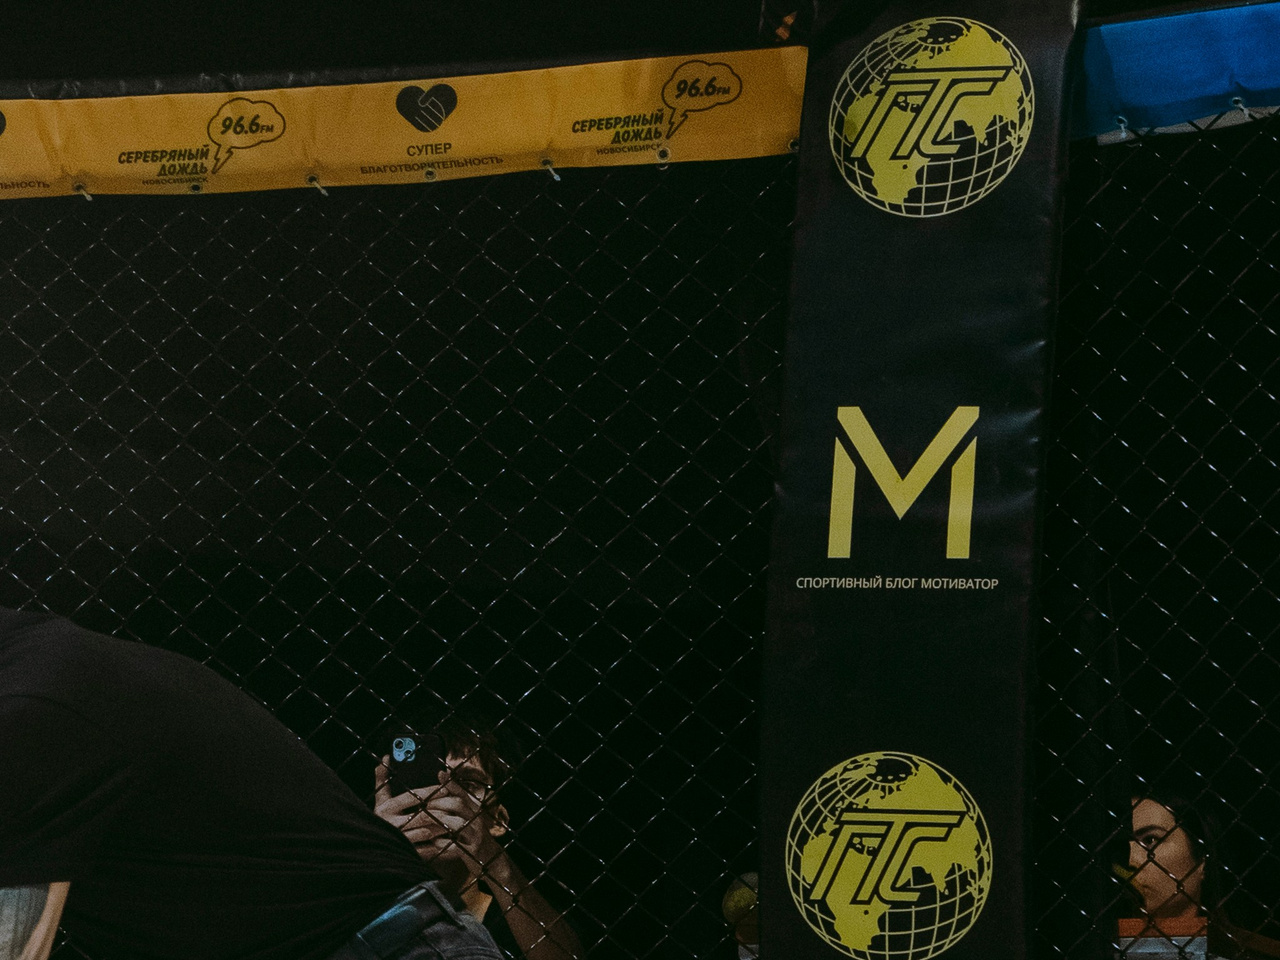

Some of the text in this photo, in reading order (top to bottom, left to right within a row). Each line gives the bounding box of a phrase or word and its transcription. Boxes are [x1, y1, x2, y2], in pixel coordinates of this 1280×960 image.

[571, 108, 665, 134] СЕРЕБРЯНЫЙ
[610, 127, 664, 145] ДОЖДЬ
[117, 144, 210, 165] СЕРЕБРЯНЫЙ
[406, 142, 453, 157] СУПЕР
[156, 162, 209, 177] ДОЖДЬ
[360, 156, 504, 175] БЛАГОТВОРИТЕЛЬНОСТЬ
[796, 575, 1000, 590] СПОРТИВНЫЙ БЛОГ МОТИВАТОР
